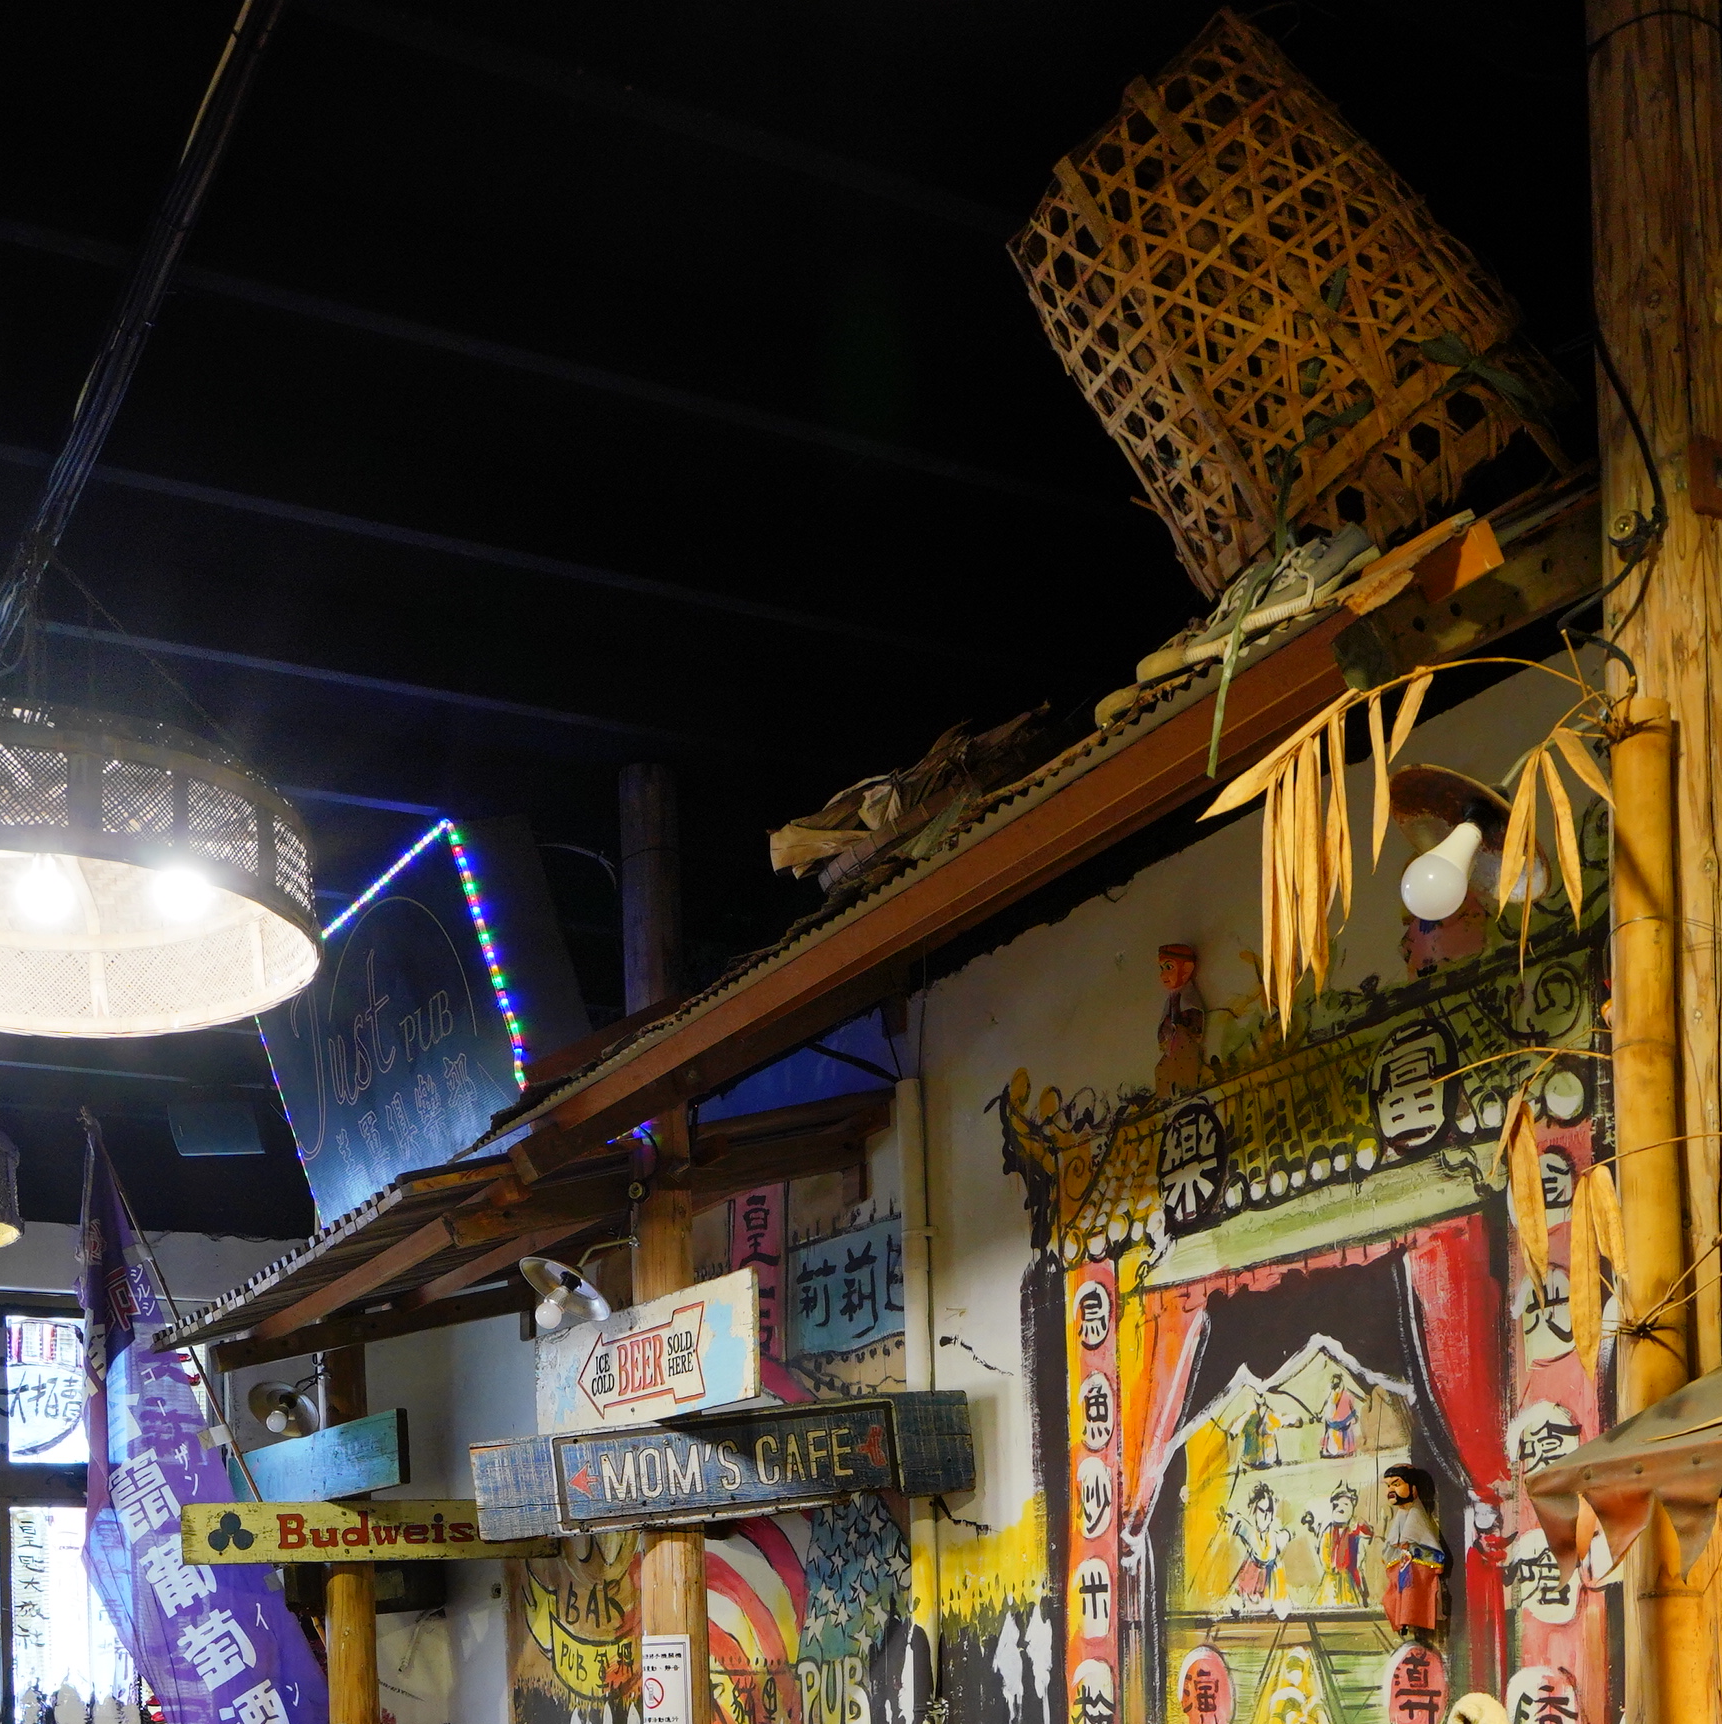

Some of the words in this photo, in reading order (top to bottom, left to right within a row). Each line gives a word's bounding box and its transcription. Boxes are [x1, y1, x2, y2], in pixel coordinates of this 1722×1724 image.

[399, 989, 454, 1062] PUB
[594, 1351, 612, 1376] ICE
[667, 1330, 693, 1357] SOLD
[617, 1333, 666, 1397] BEER
[668, 1355, 695, 1379] HERE
[591, 1375, 615, 1398] COLD
[602, 1440, 742, 1503] MOM'S
[754, 1426, 855, 1486] CAFE
[276, 1511, 476, 1550] Budweis
[565, 1578, 627, 1629] BAR
[559, 1640, 588, 1683] PUB
